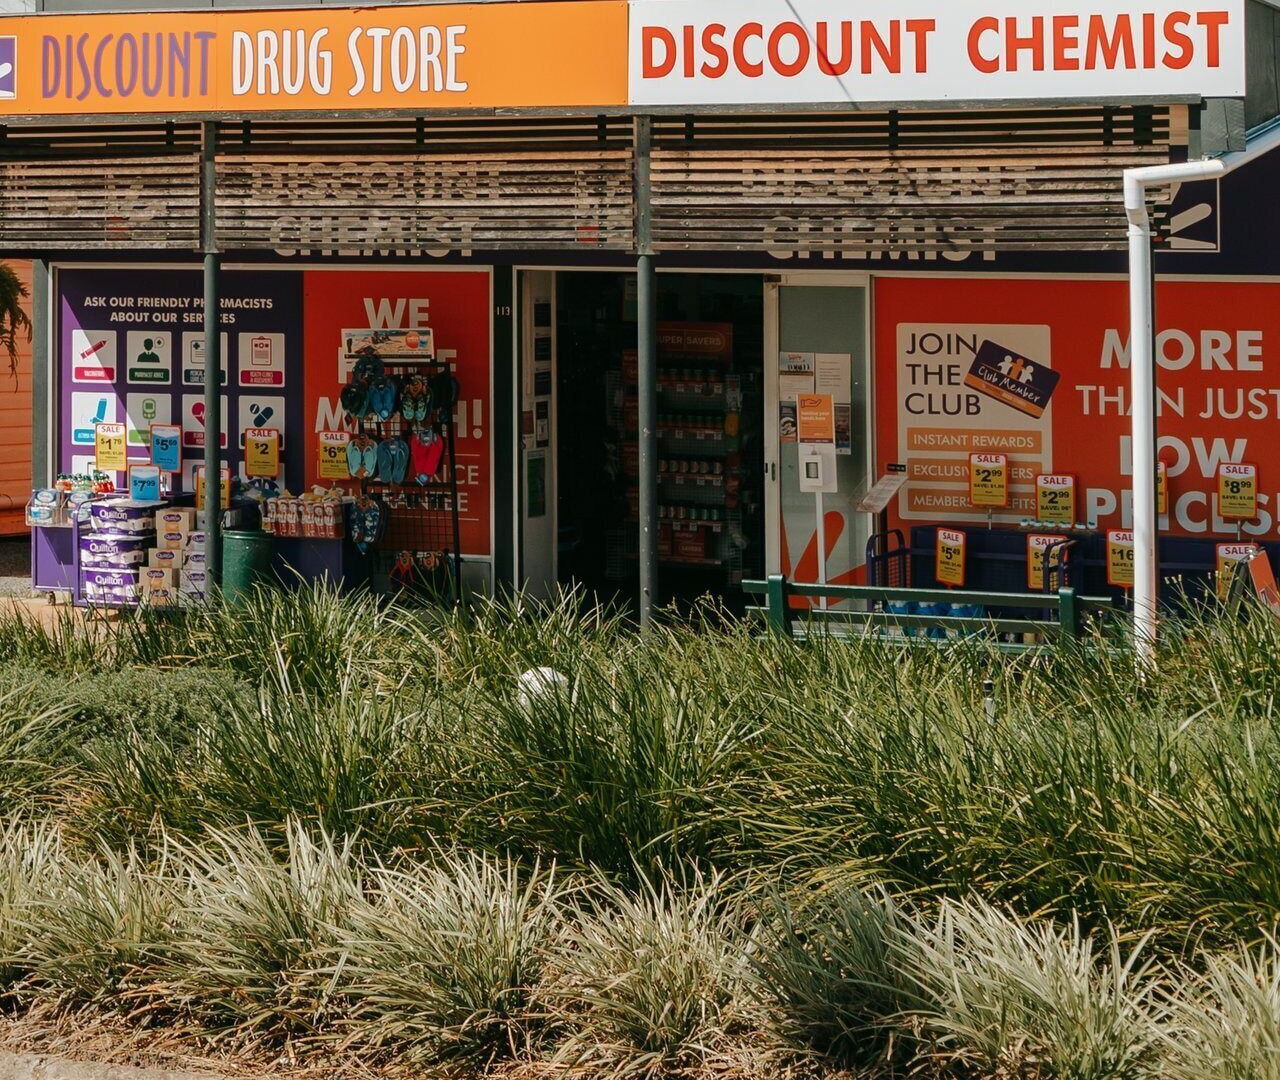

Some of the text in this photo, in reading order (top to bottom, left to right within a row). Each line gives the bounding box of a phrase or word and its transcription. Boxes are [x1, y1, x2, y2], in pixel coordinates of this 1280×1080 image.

[641, 10, 1230, 79] DISCOUNT CHEMIST
[41, 31, 217, 101] DISCOUNT
[232, 26, 332, 97] DRUG
[347, 24, 469, 97] STORE
[84, 297, 273, 309] ASK OUR FRIENDLY PHRMACISTS
[363, 298, 430, 329] WE
[496, 306, 510, 315] 113
[110, 312, 148, 322] ABOUT
[152, 312, 177, 322] OUR
[686, 335, 721, 346] SAVERS
[905, 332, 977, 355] JOIN
[1100, 328, 1263, 371] MORE
[905, 364, 960, 386] THE
[978, 365, 1041, 403] Club Member
[905, 392, 981, 416] CLUB
[1075, 385, 1184, 418] THN
[913, 434, 1034, 448] INSTANT REWARDS
[977, 455, 1000, 463] SALE
[1226, 466, 1249, 474] SALE
[1043, 477, 1067, 485] SALE
[99, 509, 128, 520] Quilton
[942, 532, 959, 542] SALE
[1115, 533, 1134, 541] SAL
[90, 543, 119, 554] Quilton
[1225, 547, 1251, 555] SALE
[95, 576, 124, 586] Quilton
